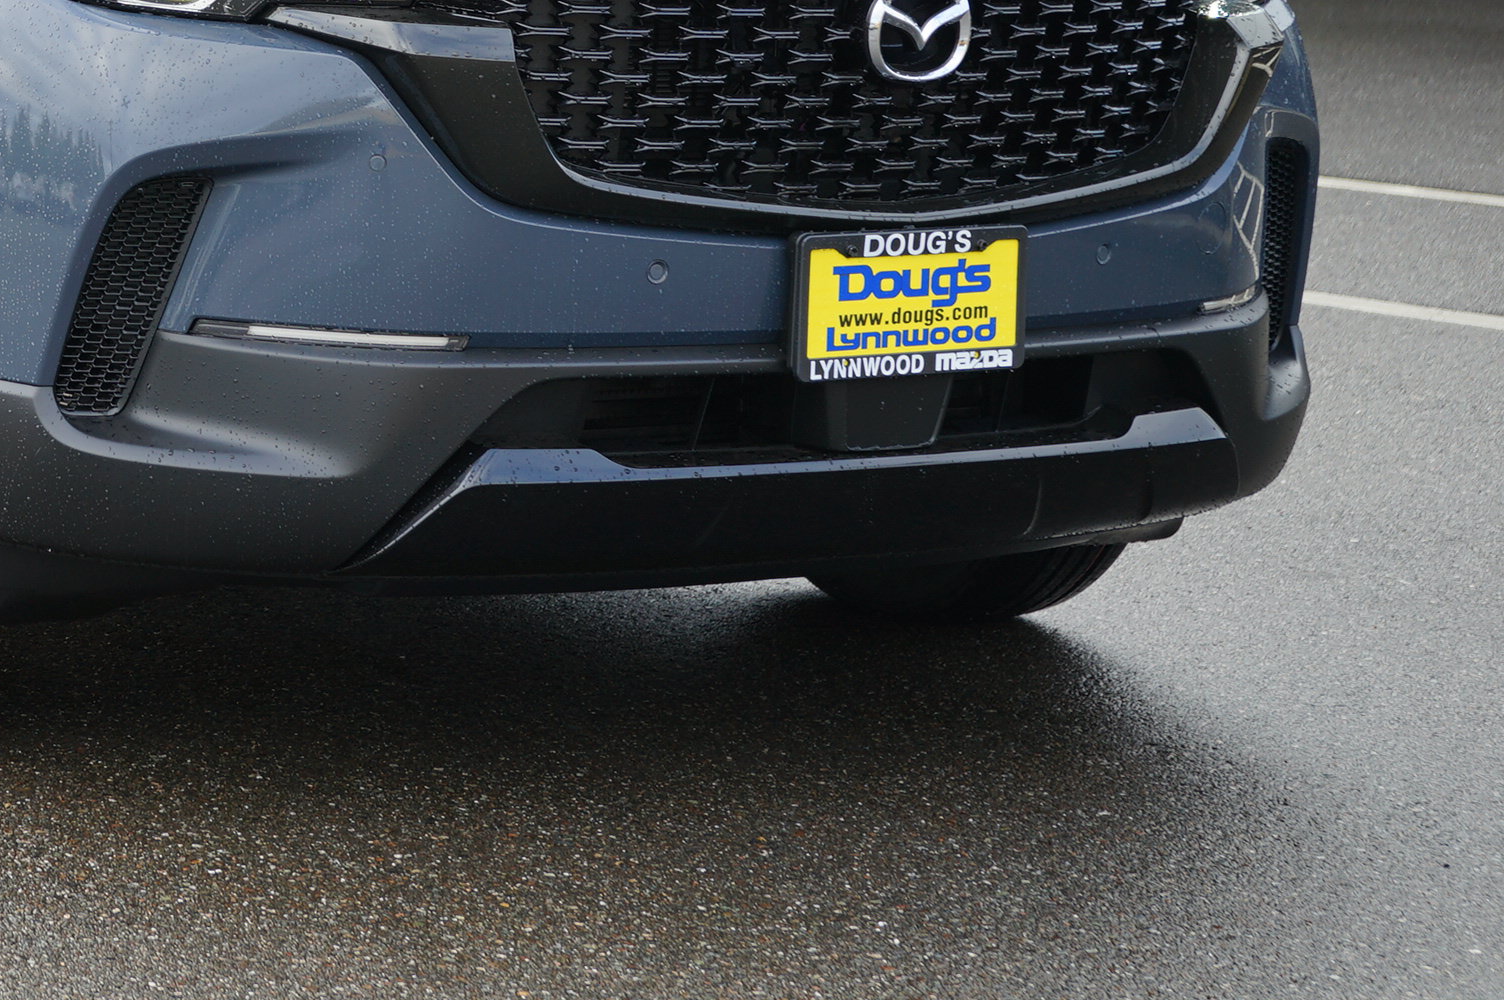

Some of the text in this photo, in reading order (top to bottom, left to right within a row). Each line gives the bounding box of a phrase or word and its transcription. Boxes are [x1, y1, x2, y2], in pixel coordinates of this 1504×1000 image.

[862, 229, 972, 258] DOUG'S
[832, 258, 991, 308] Doug's
[838, 305, 989, 327] www.dougs.com
[826, 317, 997, 352] Lynnwood
[809, 354, 925, 381] LYNNWOOD
